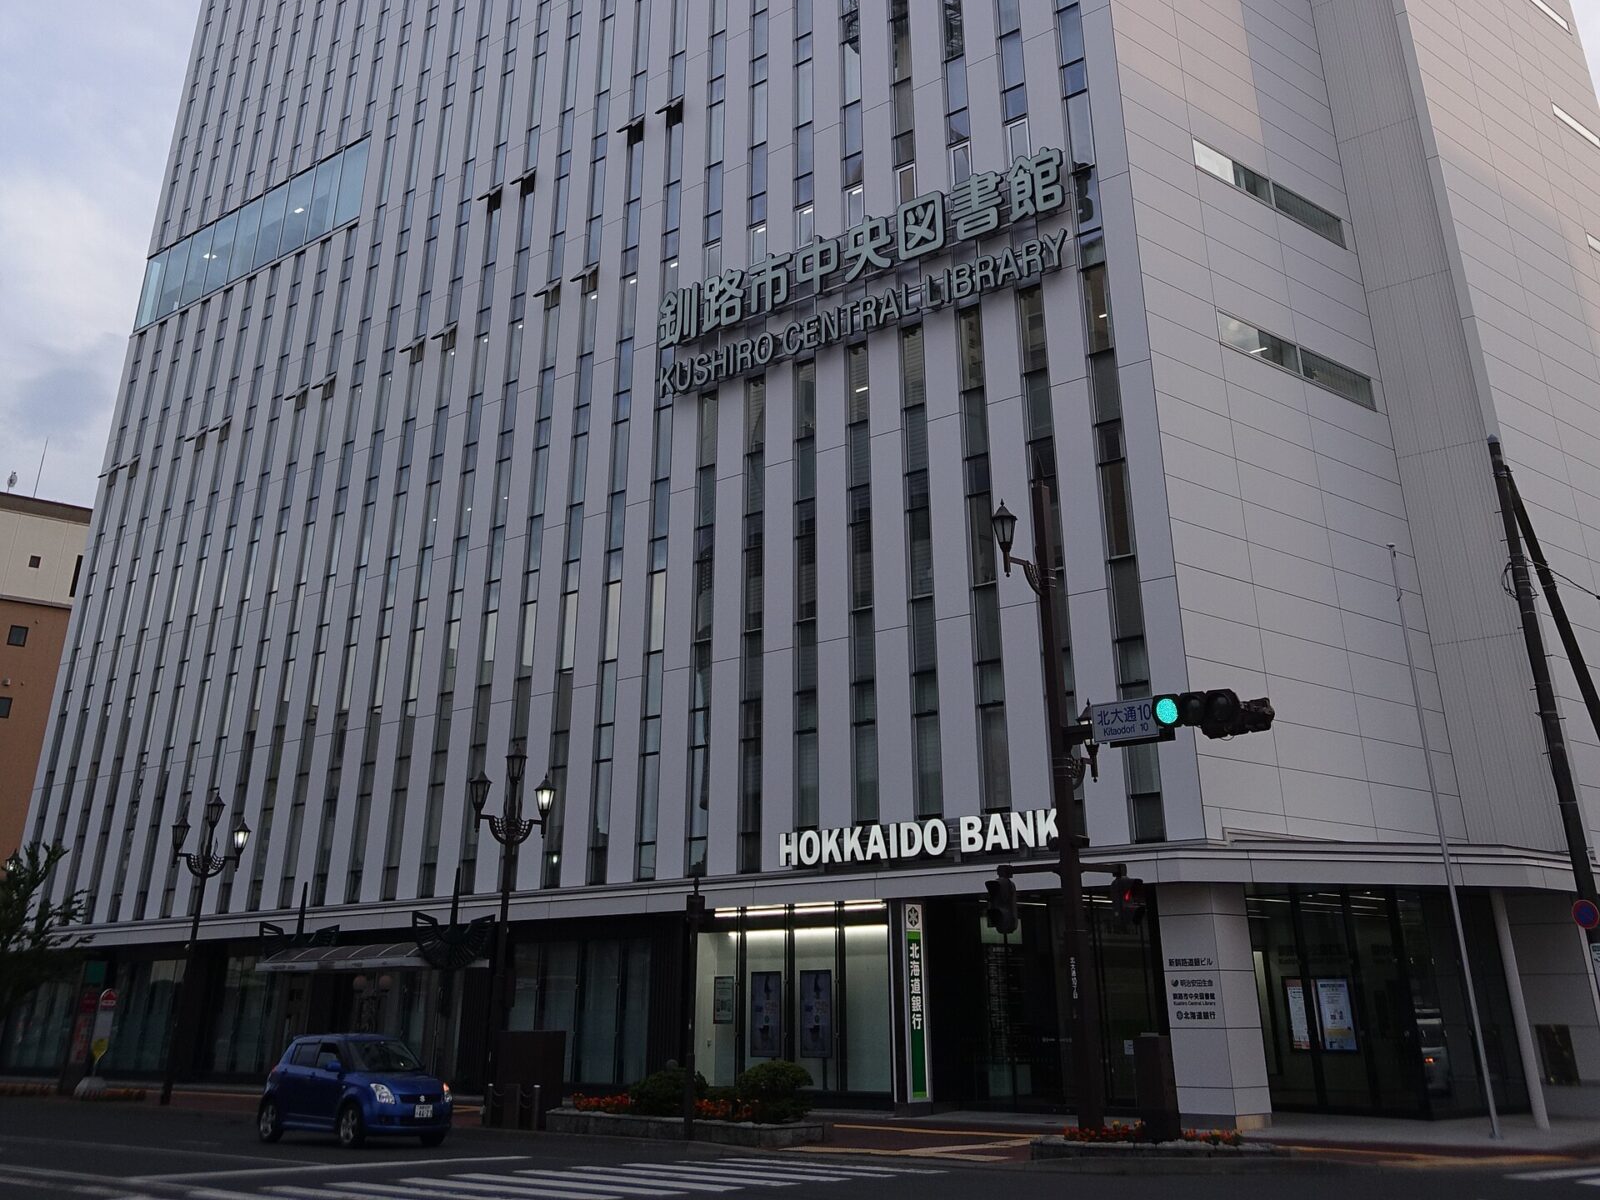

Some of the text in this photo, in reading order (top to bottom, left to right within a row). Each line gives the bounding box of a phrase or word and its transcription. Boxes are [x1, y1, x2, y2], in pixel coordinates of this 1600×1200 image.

[658, 146, 1065, 349] 釧路市中央図書館
[658, 227, 1067, 398] KUSHIRO CENTRAL LIBRARY
[1097, 703, 1152, 726] 北大通10
[1103, 723, 1149, 737] Kitaodori 10
[778, 808, 1060, 867] HOKKAIDO BANK
[909, 942, 924, 1030] 北海道銀行
